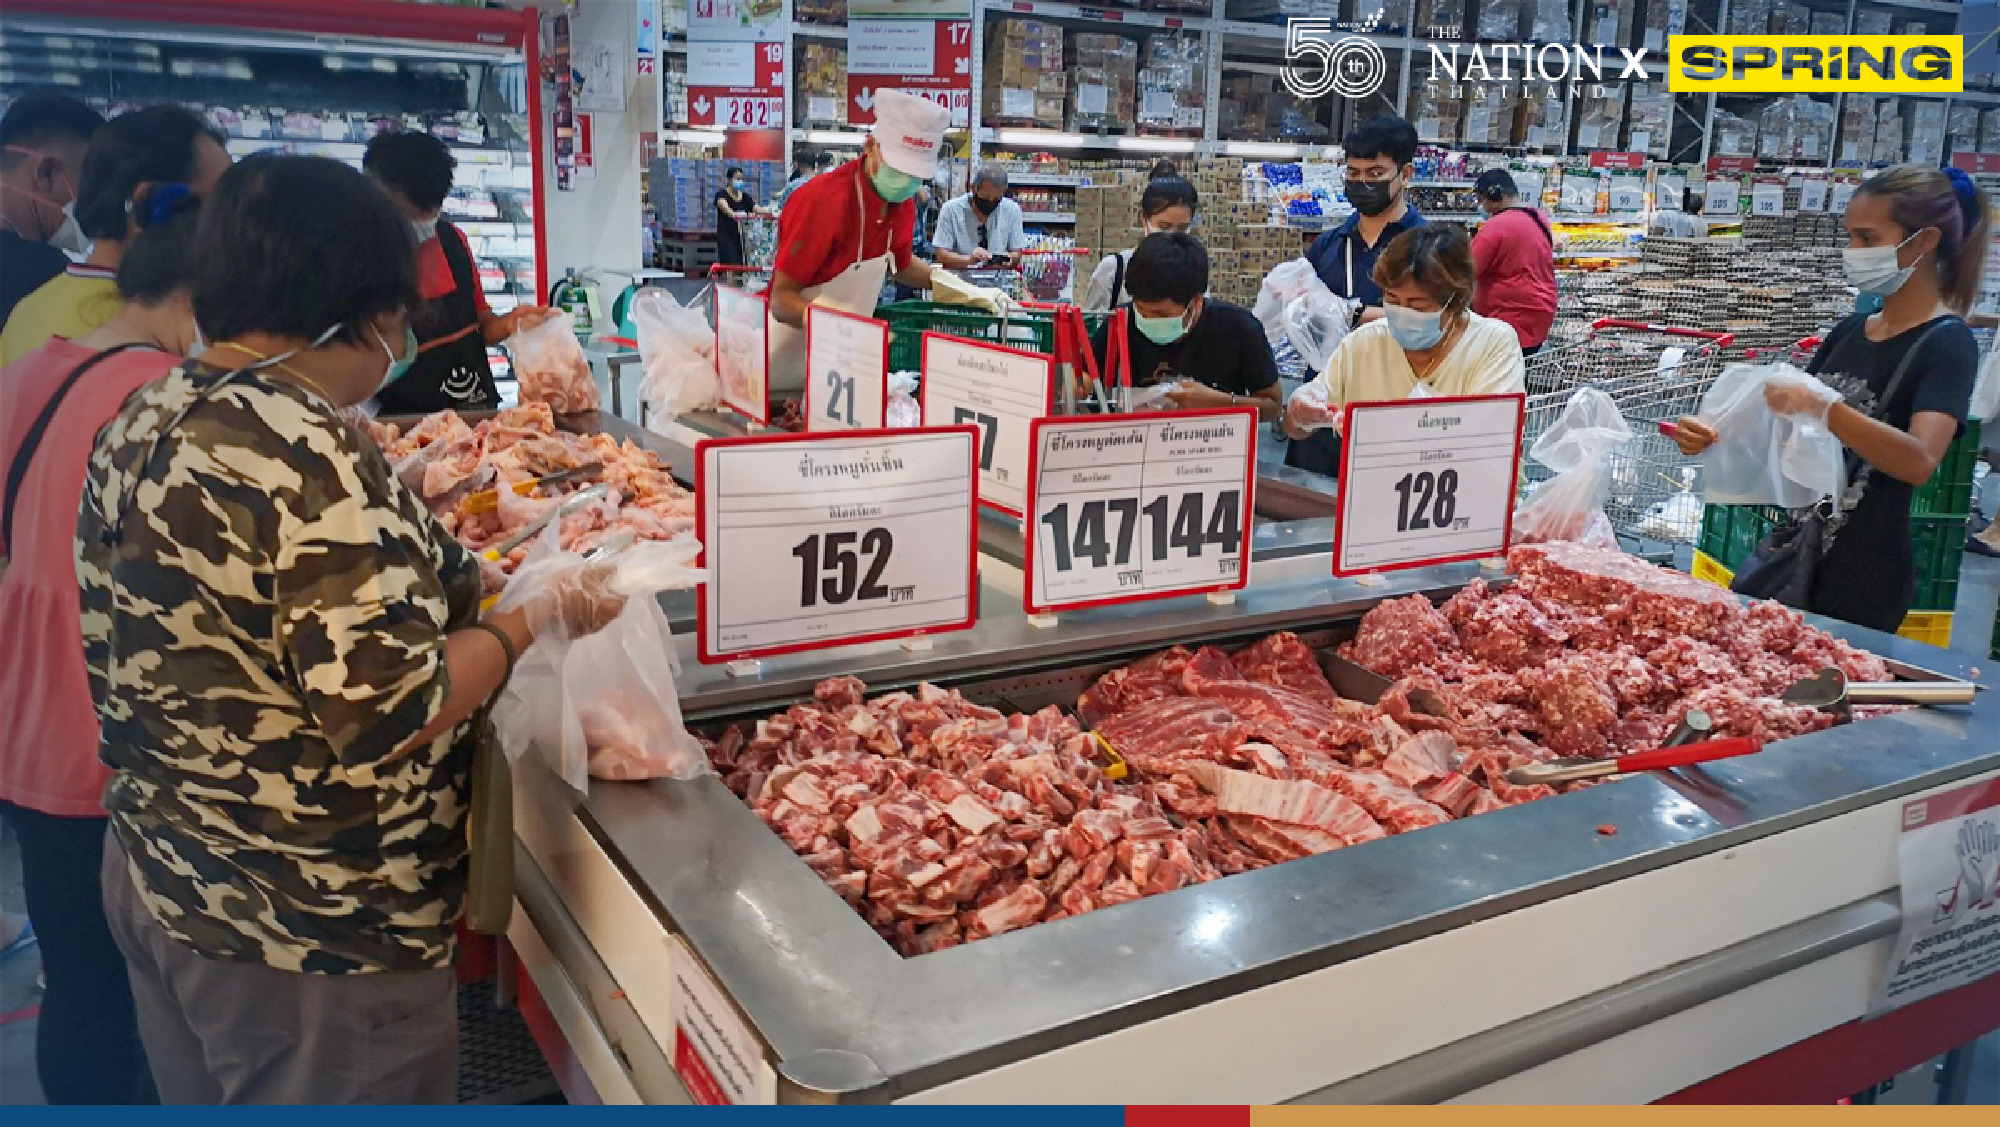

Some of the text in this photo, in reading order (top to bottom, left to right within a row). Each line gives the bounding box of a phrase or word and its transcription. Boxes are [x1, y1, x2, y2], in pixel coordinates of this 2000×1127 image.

[763, 44, 783, 63] 19
[947, 22, 971, 45] 17
[729, 101, 767, 125] 282
[827, 370, 855, 426] 21
[1143, 490, 1243, 561] 144
[1395, 468, 1459, 532] 128
[792, 527, 916, 607] 152 บาท
[1042, 498, 1138, 572] 147
[1117, 570, 1142, 586] บาท
